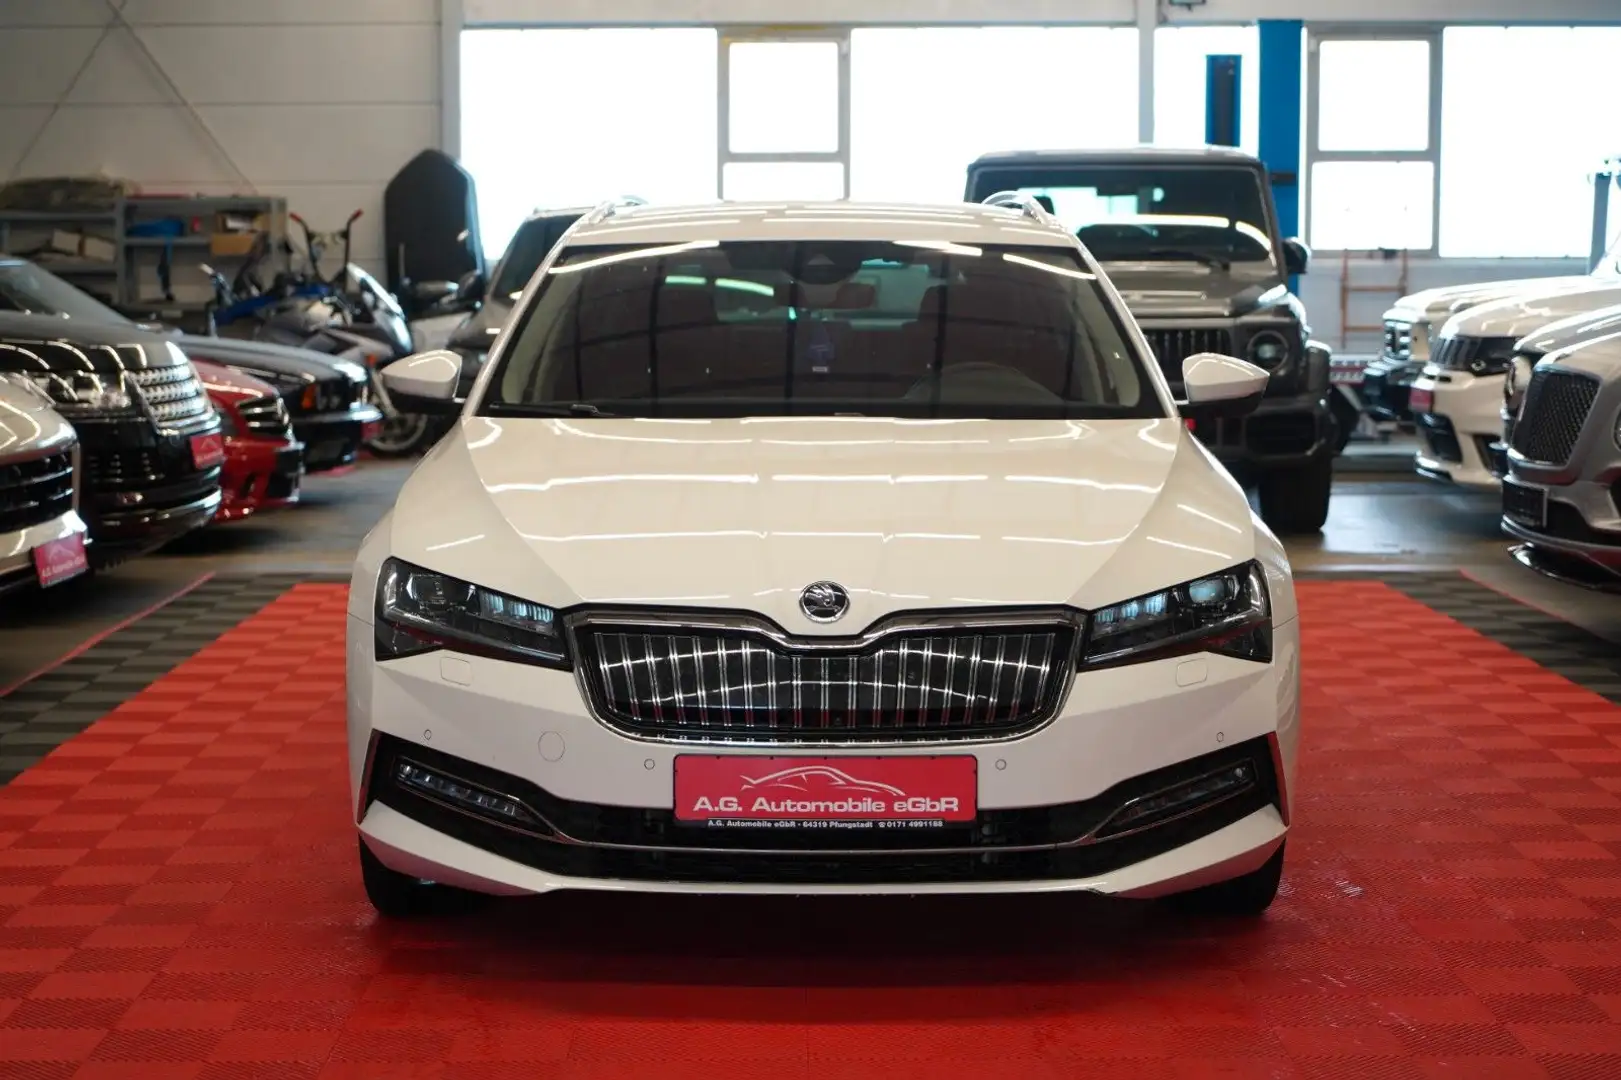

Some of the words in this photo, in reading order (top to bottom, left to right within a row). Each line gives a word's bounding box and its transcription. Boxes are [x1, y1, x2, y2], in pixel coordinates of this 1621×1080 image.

[692, 796, 742, 812] A.G.
[752, 797, 885, 813] Automobile
[893, 797, 959, 813] eGbR
[707, 819, 724, 827] A.G.
[726, 819, 772, 828] Automobile
[773, 820, 796, 828] eGbR
[803, 820, 828, 828] 64319
[829, 821, 873, 829] Pfungstadt
[886, 820, 907, 828] 0171
